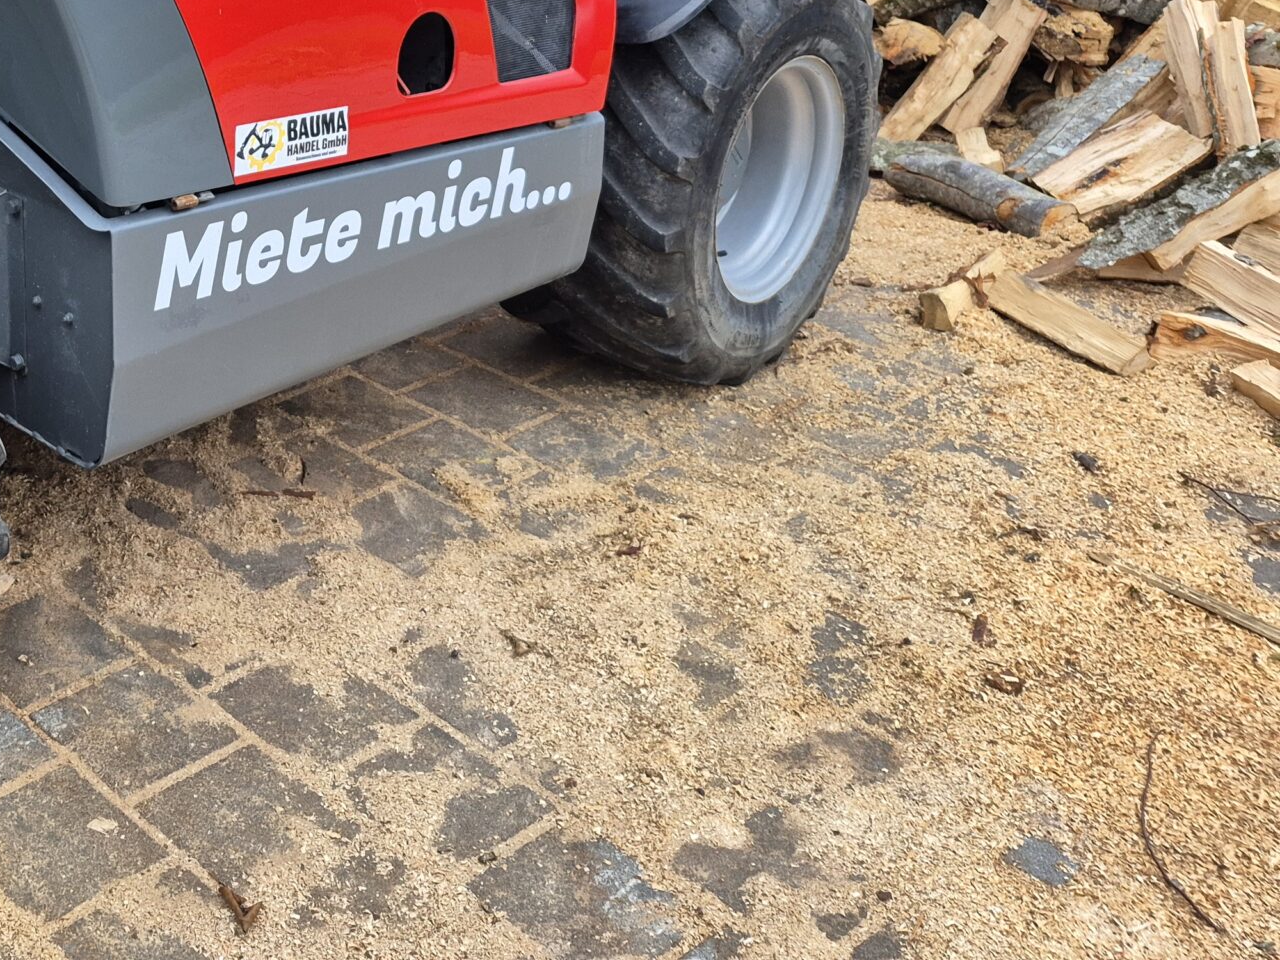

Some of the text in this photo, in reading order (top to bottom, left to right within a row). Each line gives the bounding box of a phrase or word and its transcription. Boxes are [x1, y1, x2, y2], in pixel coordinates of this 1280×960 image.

[287, 110, 347, 142] BAUMA
[287, 139, 320, 156] HANDEL
[321, 135, 347, 150] GmbH
[153, 146, 572, 312] Miete mich...
